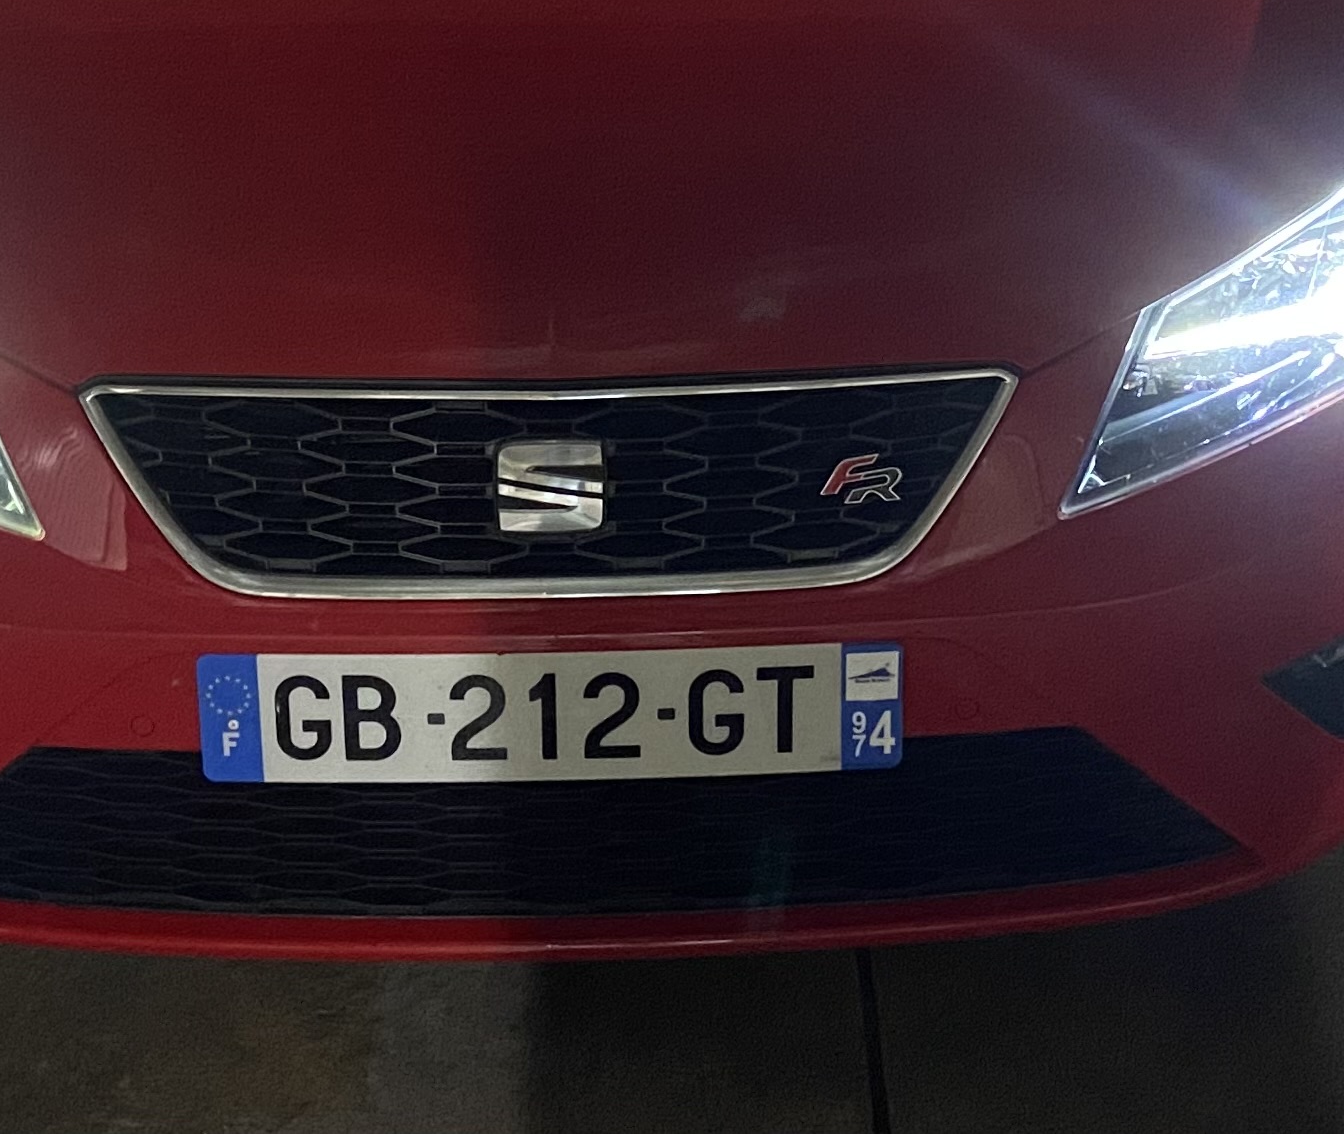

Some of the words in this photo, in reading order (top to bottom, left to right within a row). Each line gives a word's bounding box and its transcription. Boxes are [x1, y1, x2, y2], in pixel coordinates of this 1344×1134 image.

[821, 453, 902, 504] FR
[274, 665, 815, 762] GB-212-GT
[221, 731, 241, 757] F
